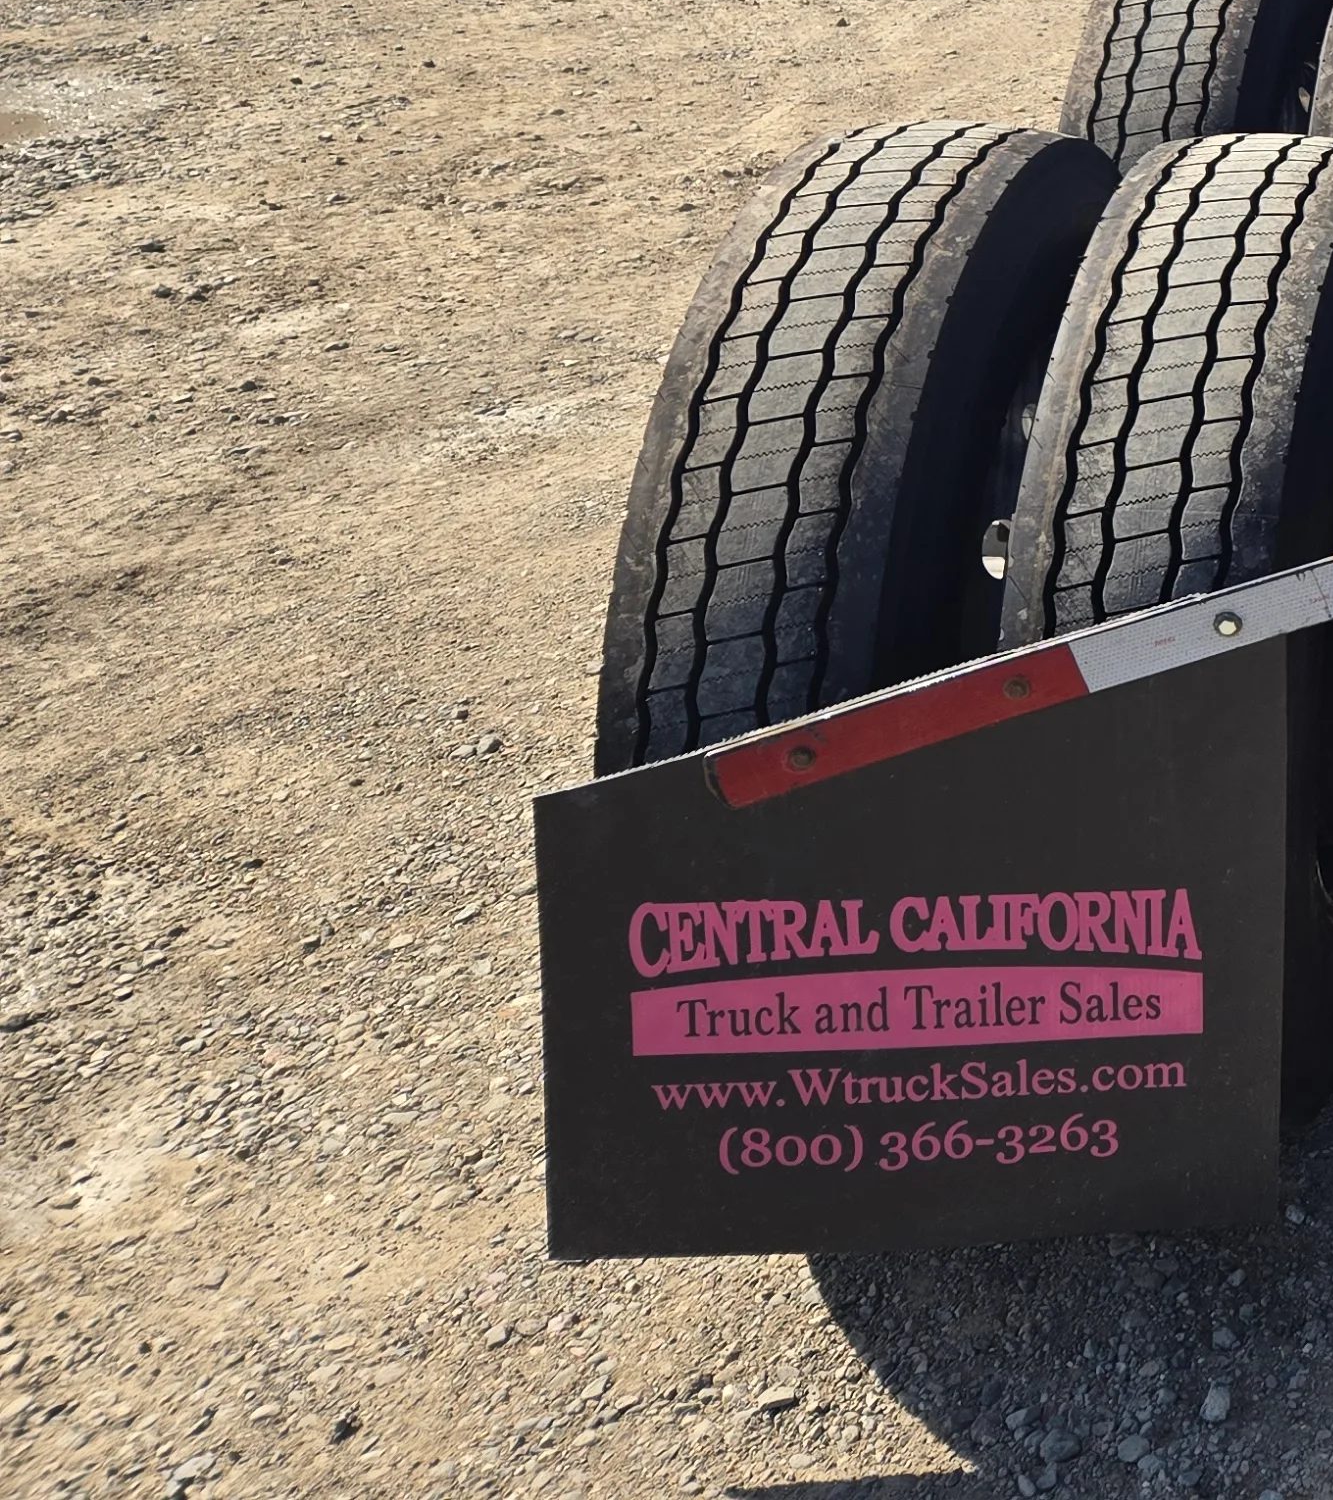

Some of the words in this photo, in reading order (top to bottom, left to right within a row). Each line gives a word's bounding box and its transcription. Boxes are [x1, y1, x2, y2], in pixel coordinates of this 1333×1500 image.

[628, 898, 880, 979] CENTRAL
[889, 887, 1203, 961] CALIFORNIA
[676, 990, 801, 1040] Truck
[813, 988, 891, 1035] and
[903, 982, 1047, 1033] Trailer
[1058, 980, 1163, 1025] Sales
[651, 1057, 1188, 1112] www.WtruckSales.com
[718, 1124, 865, 1176] (800)
[877, 1112, 1121, 1173] 366-3263
